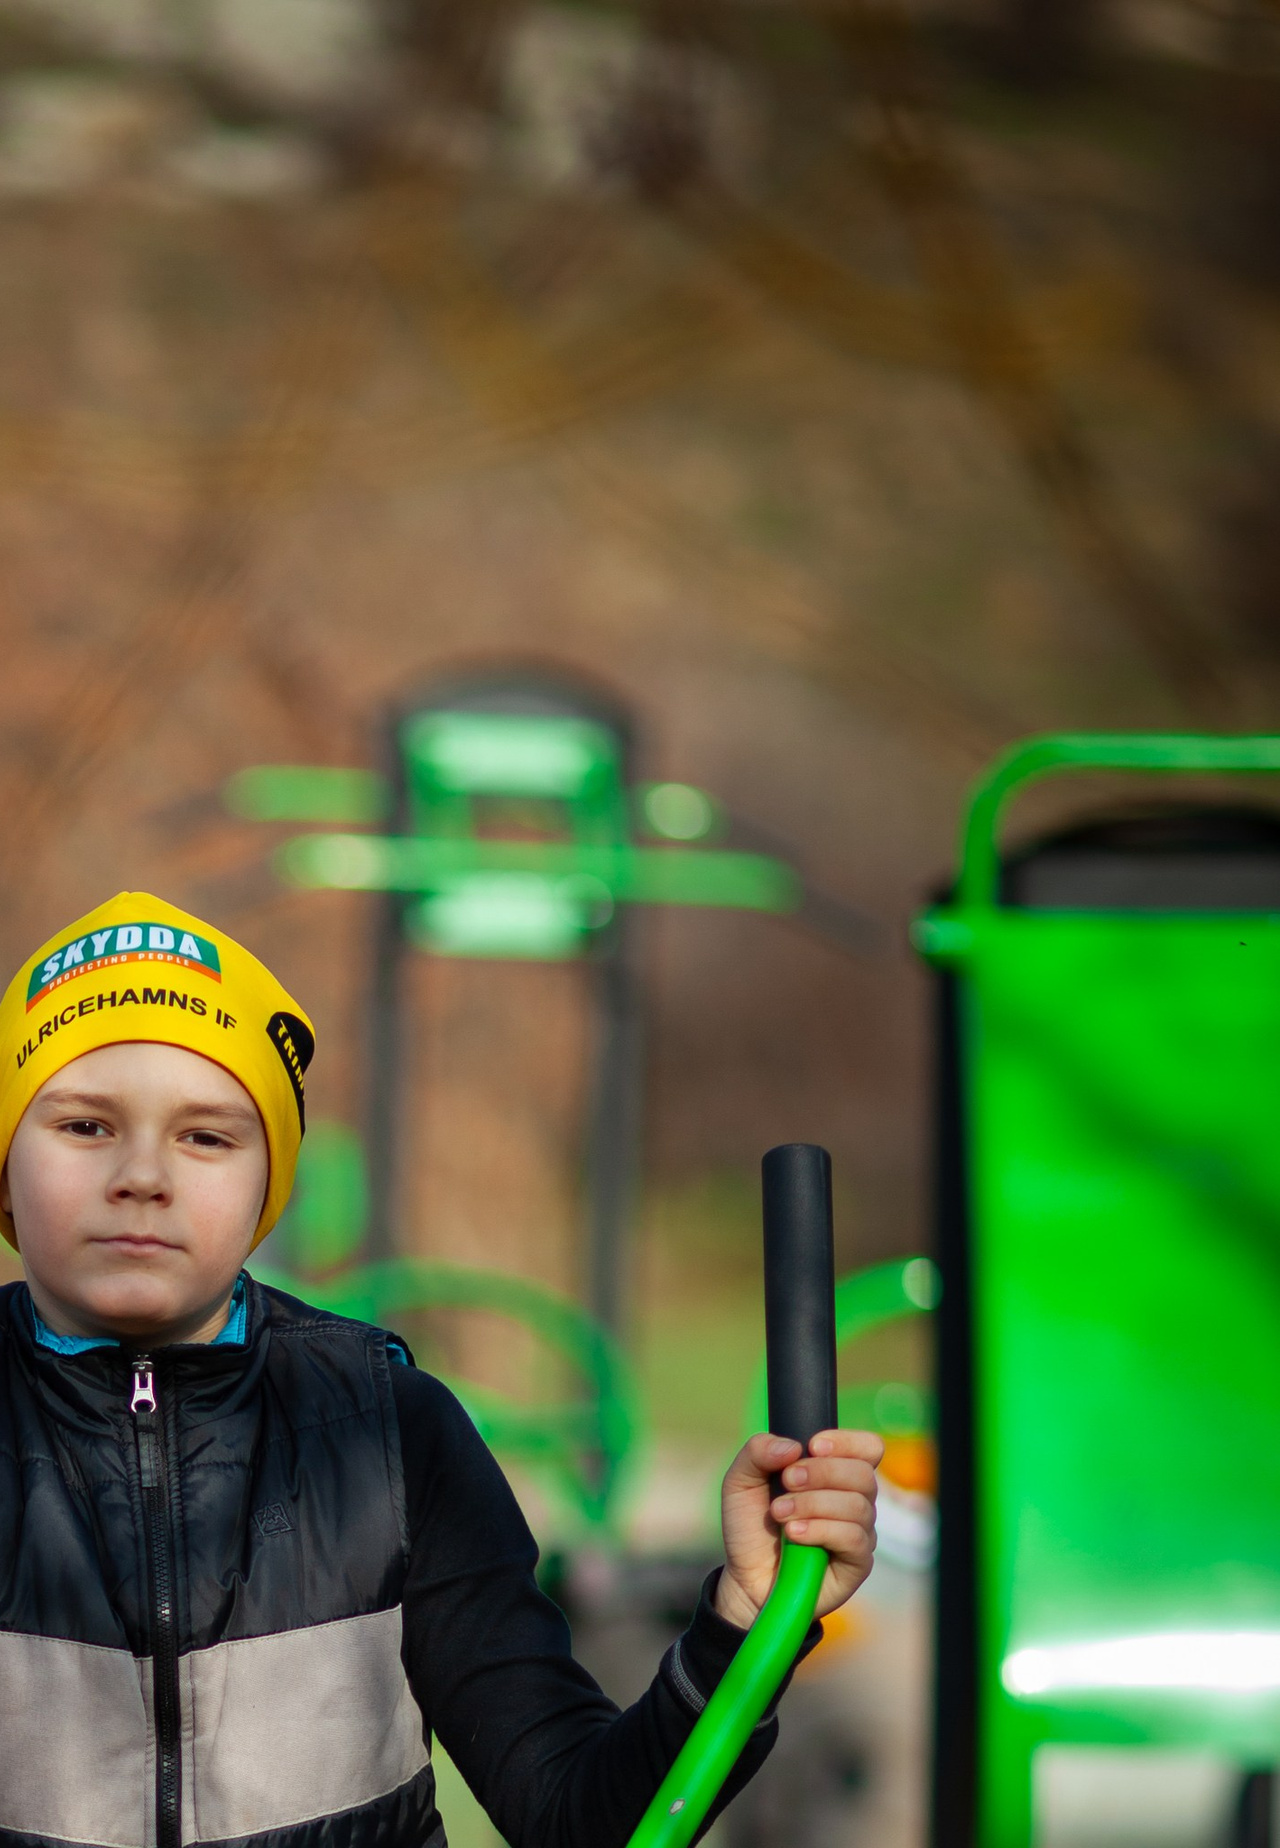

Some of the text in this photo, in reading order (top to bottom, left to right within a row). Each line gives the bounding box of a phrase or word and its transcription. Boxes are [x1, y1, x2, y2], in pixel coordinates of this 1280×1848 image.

[40, 925, 203, 984] SKYDDA
[49, 952, 190, 991] PROTECTING PEOPLE
[16, 987, 238, 1070] ULRICEHAMNS IF
[277, 1018, 305, 1091] TRIM
